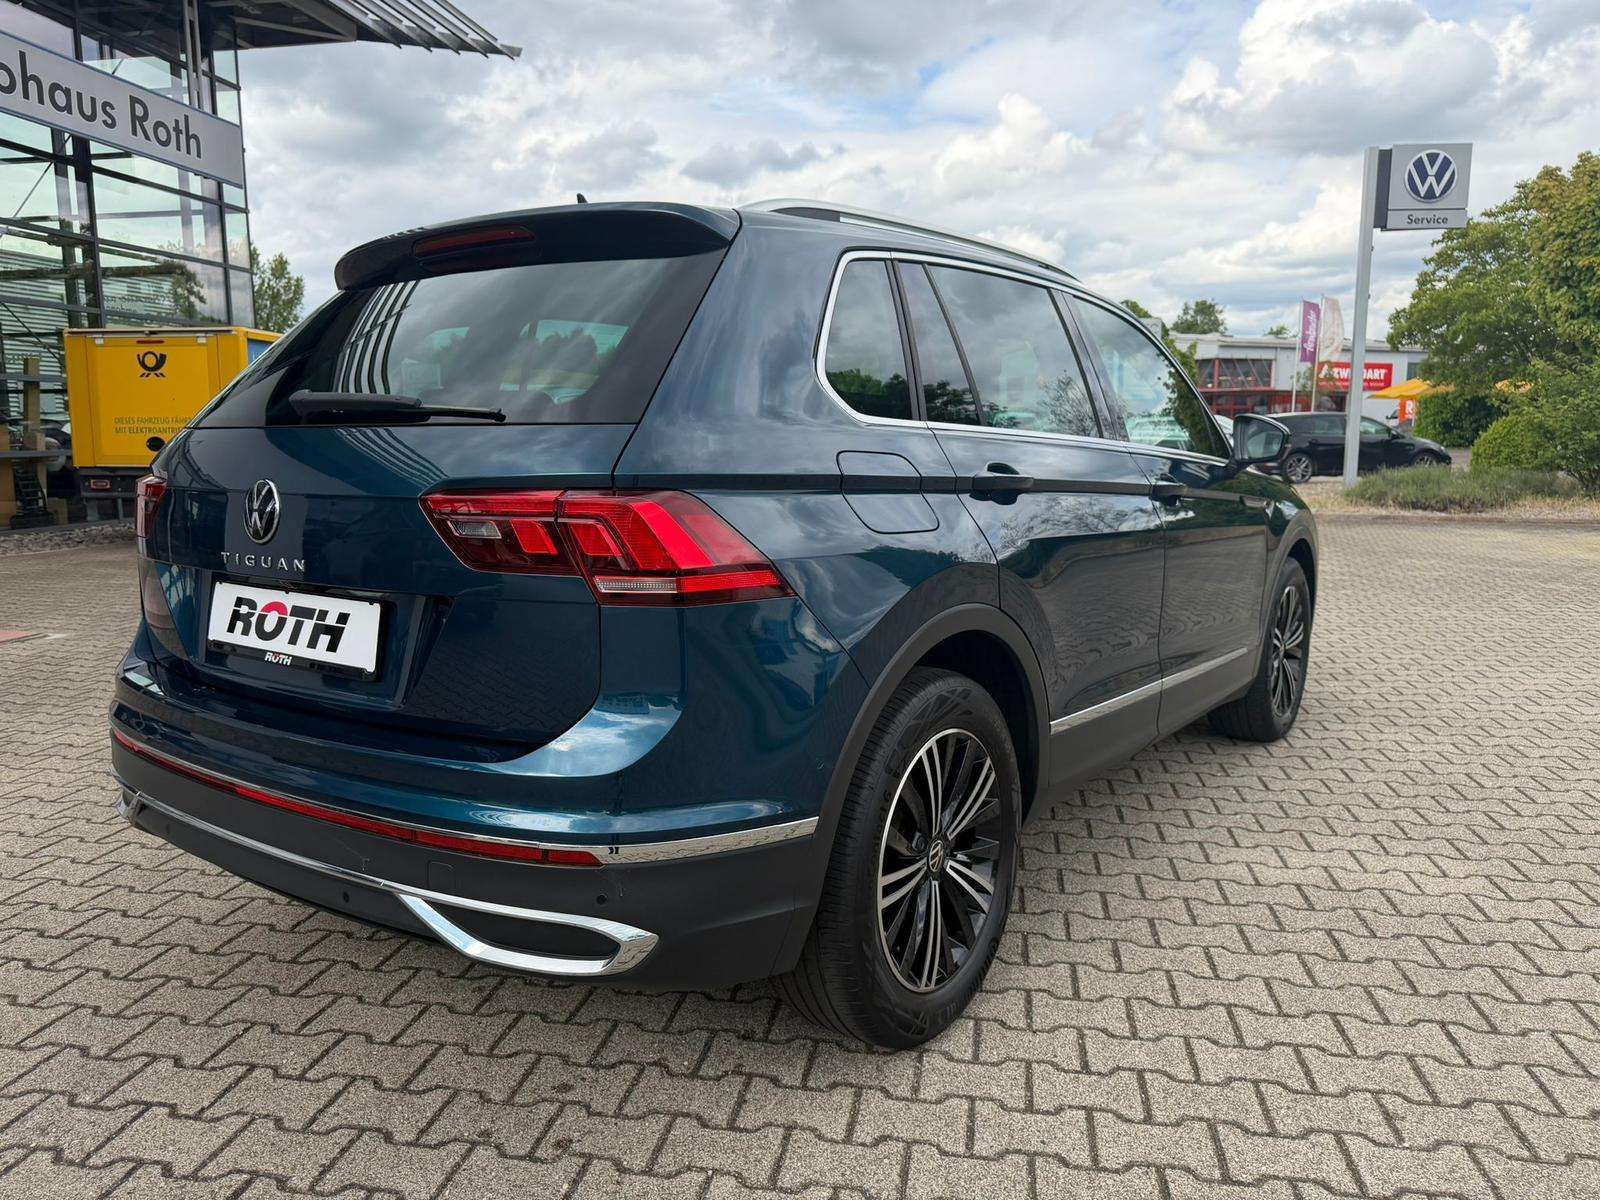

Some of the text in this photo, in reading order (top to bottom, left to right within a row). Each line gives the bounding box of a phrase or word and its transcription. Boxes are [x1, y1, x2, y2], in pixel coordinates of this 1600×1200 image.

[129, 94, 202, 159] Roth
[1407, 213, 1448, 225] Service
[114, 416, 135, 425] DIESES
[136, 416, 170, 425] FAHRZEUG
[115, 426, 181, 435] MIT ELEKTROANTRIE
[220, 551, 306, 573] TIGUAN
[226, 596, 351, 653] ROTH
[264, 652, 293, 666] ROTH
